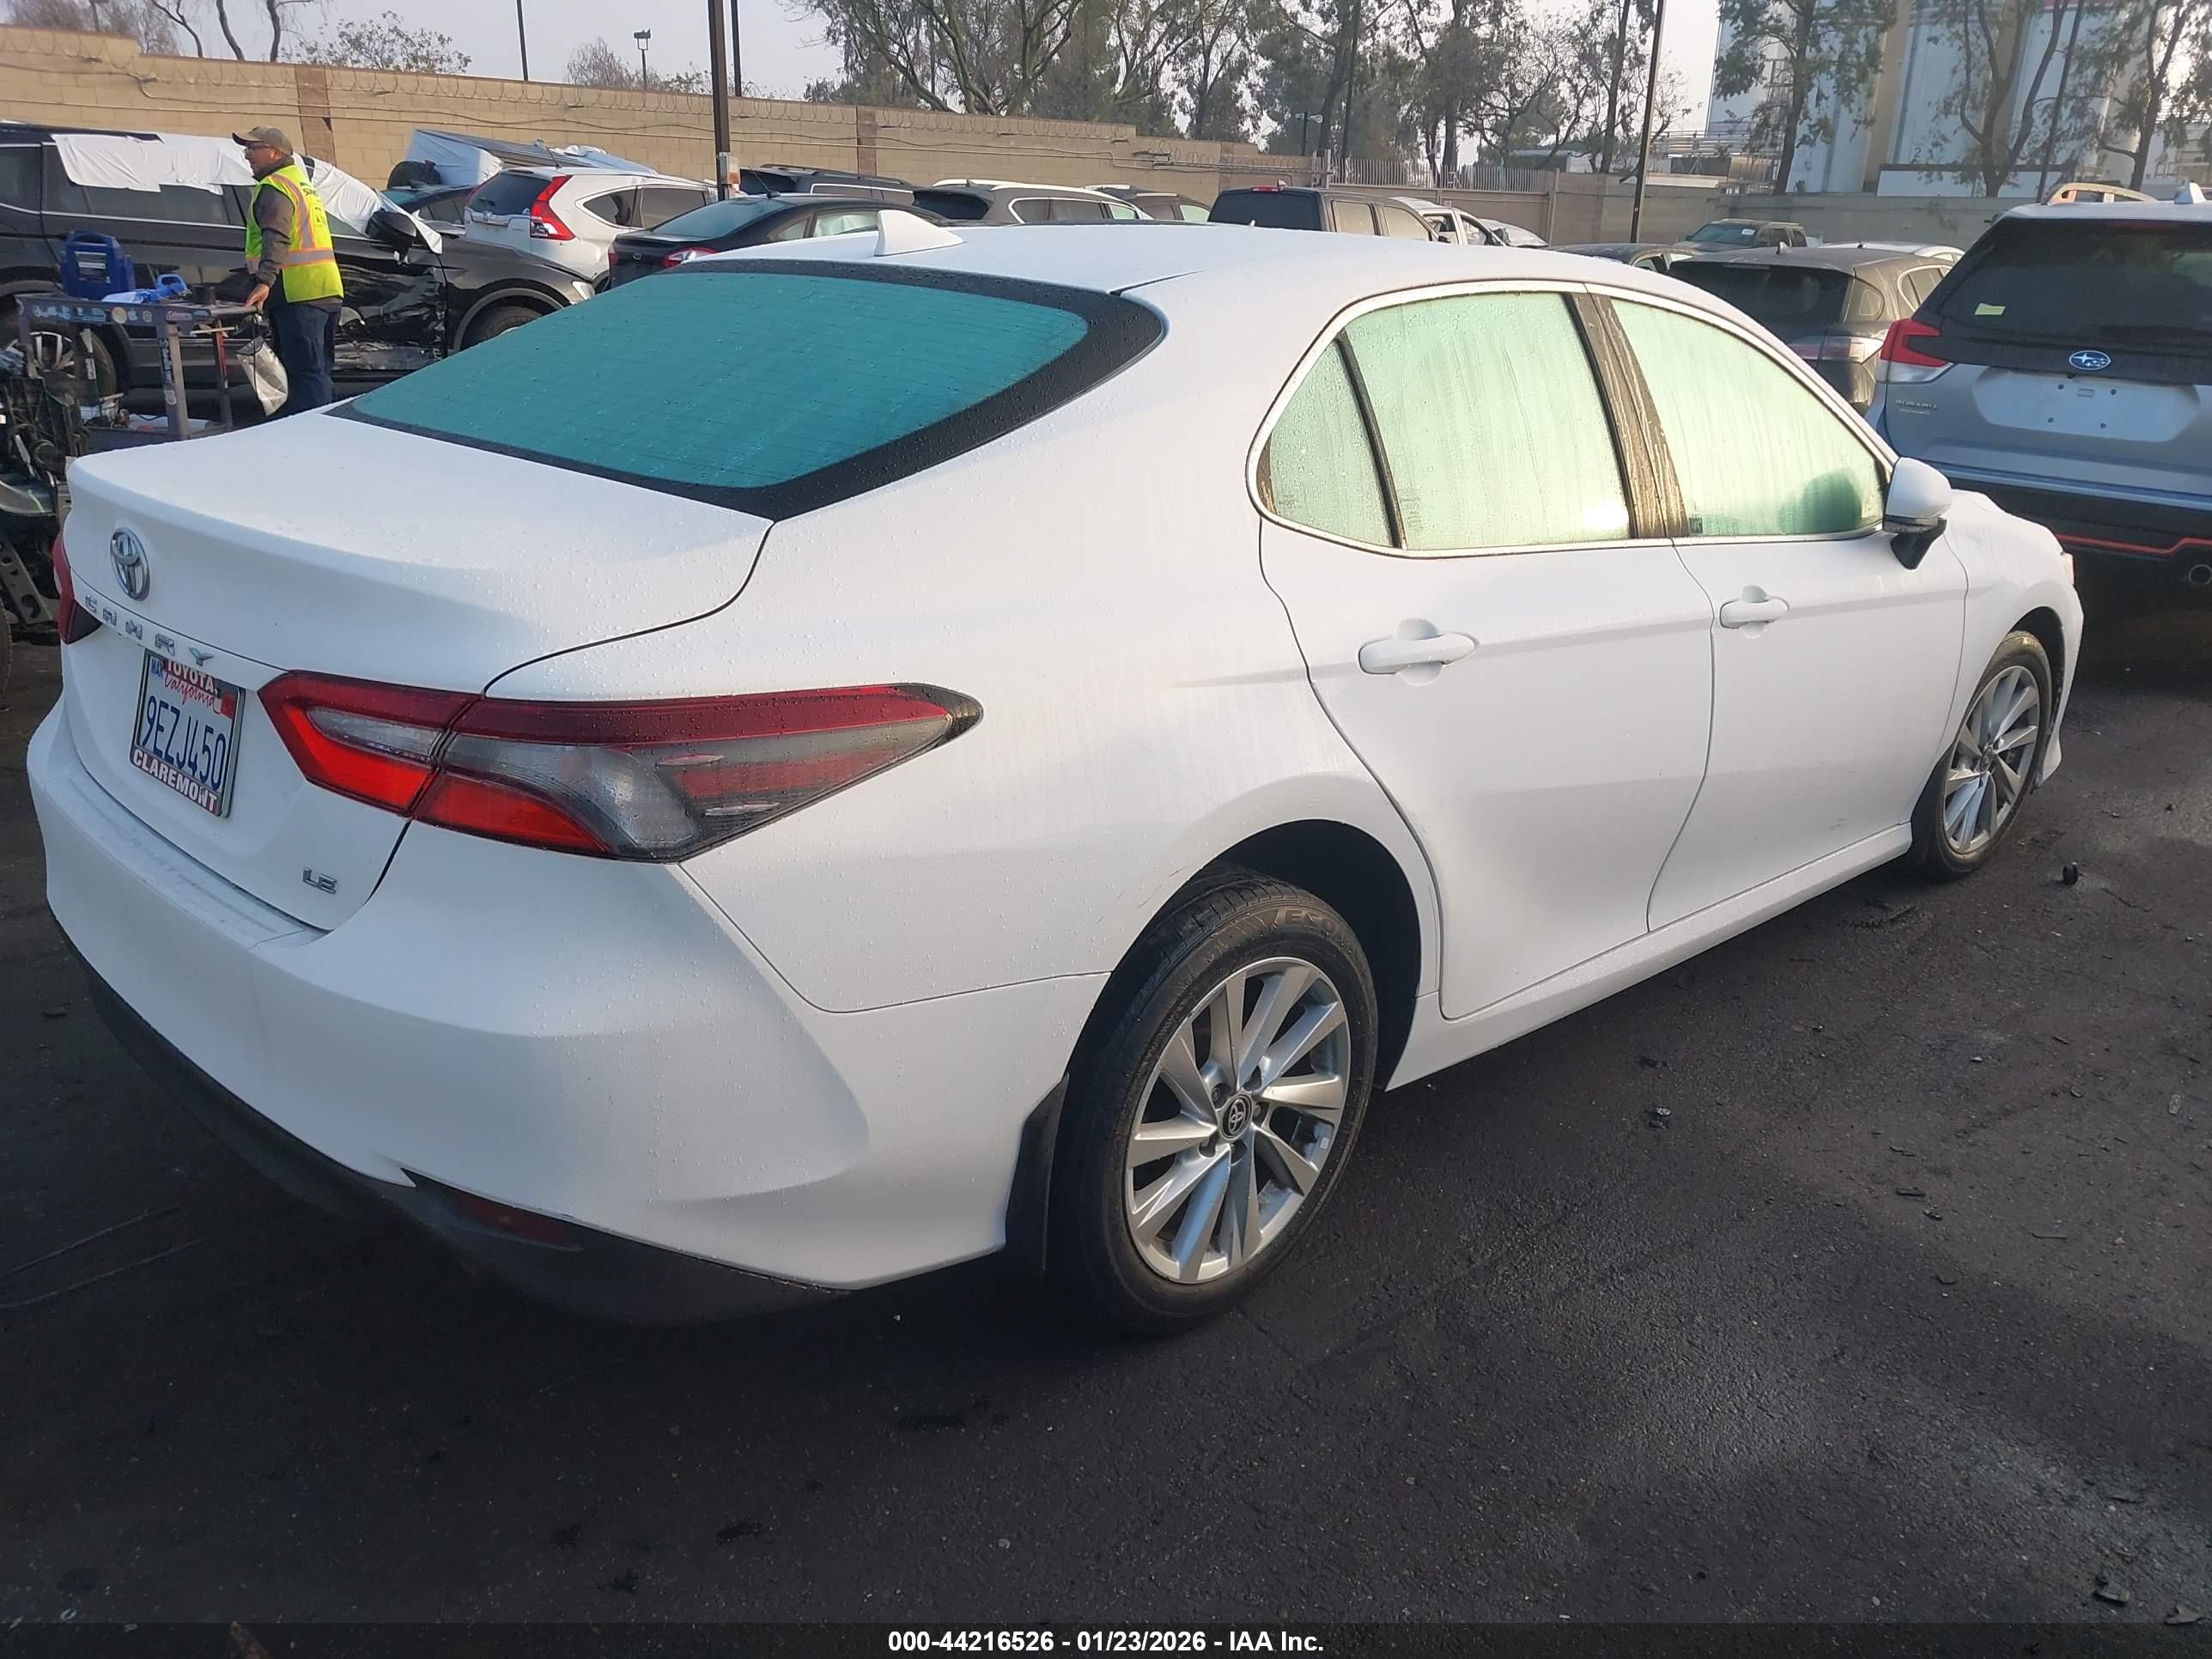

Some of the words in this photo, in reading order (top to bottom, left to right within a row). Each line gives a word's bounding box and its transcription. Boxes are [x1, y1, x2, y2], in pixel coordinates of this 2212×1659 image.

[85, 594, 214, 666] CAMRY
[167, 659, 214, 694] TOYOTA
[142, 695, 227, 792] 9EZJ450
[133, 749, 217, 811] CLAREMONT
[302, 867, 337, 894] LE
